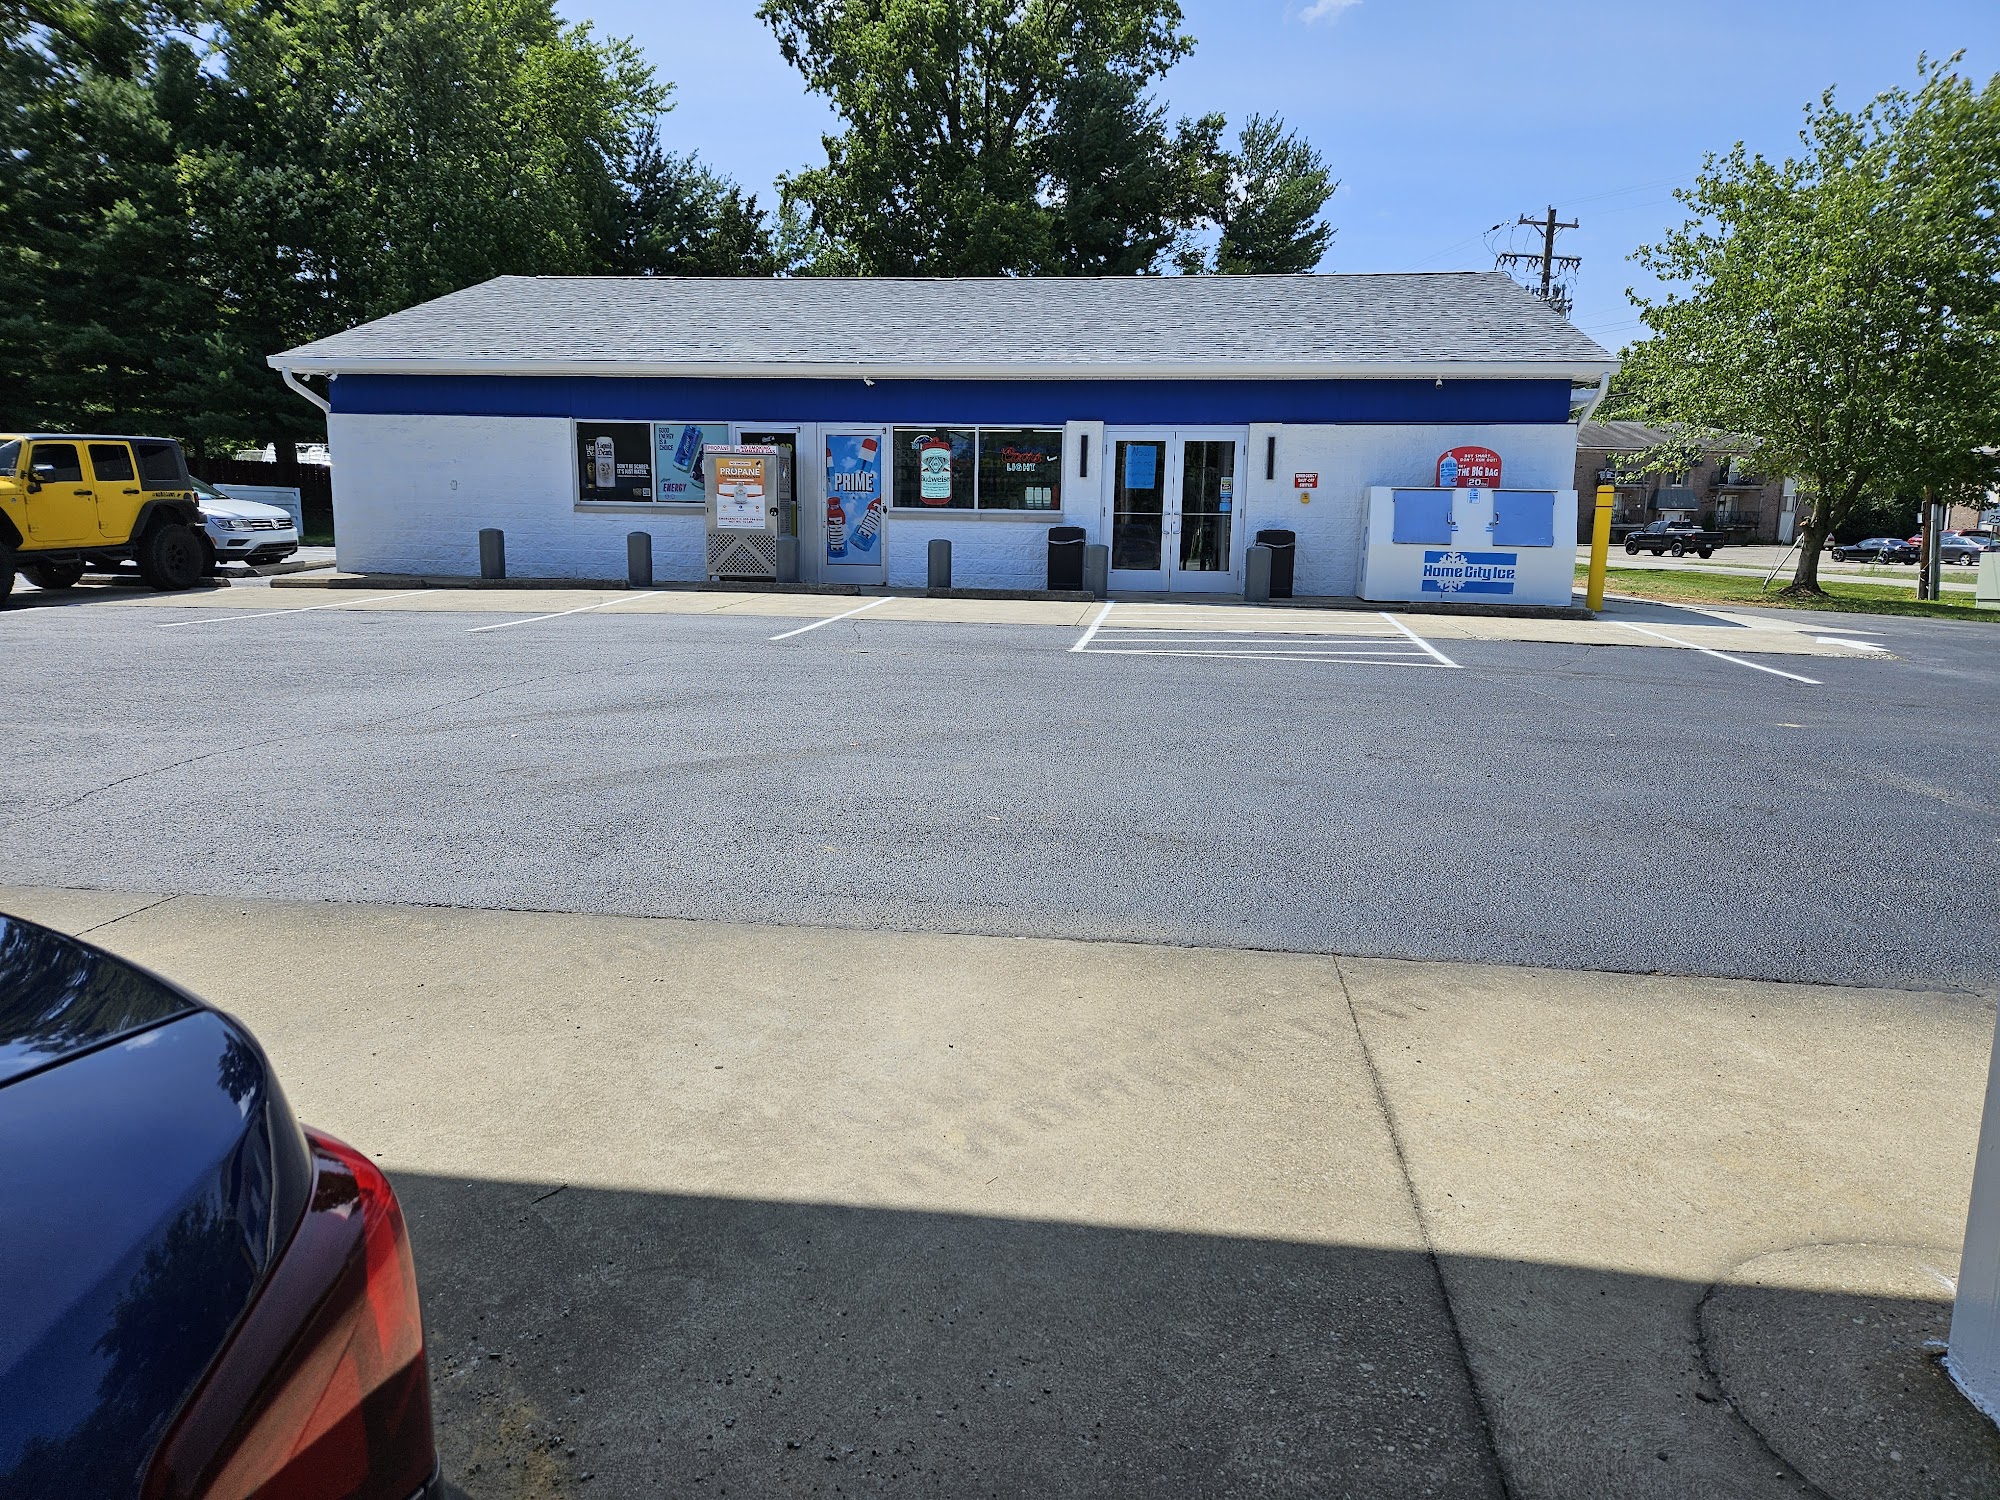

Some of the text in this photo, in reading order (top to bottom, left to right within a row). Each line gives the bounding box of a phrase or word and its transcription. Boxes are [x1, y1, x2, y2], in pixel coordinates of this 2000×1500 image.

[1001, 447, 1042, 462] Coors
[1132, 447, 1150, 456] Now
[720, 467, 760, 476] PROPANE
[1007, 463, 1036, 472] LIGHT
[1457, 468, 1470, 477] THE
[1471, 466, 1484, 477] BIG
[1484, 467, 1499, 477] BAG
[663, 483, 687, 492] ENERGY
[834, 472, 874, 492] PRIME
[857, 503, 881, 539] PRIME
[828, 517, 845, 551] PRIME
[1423, 565, 1515, 581] Home City Ice
